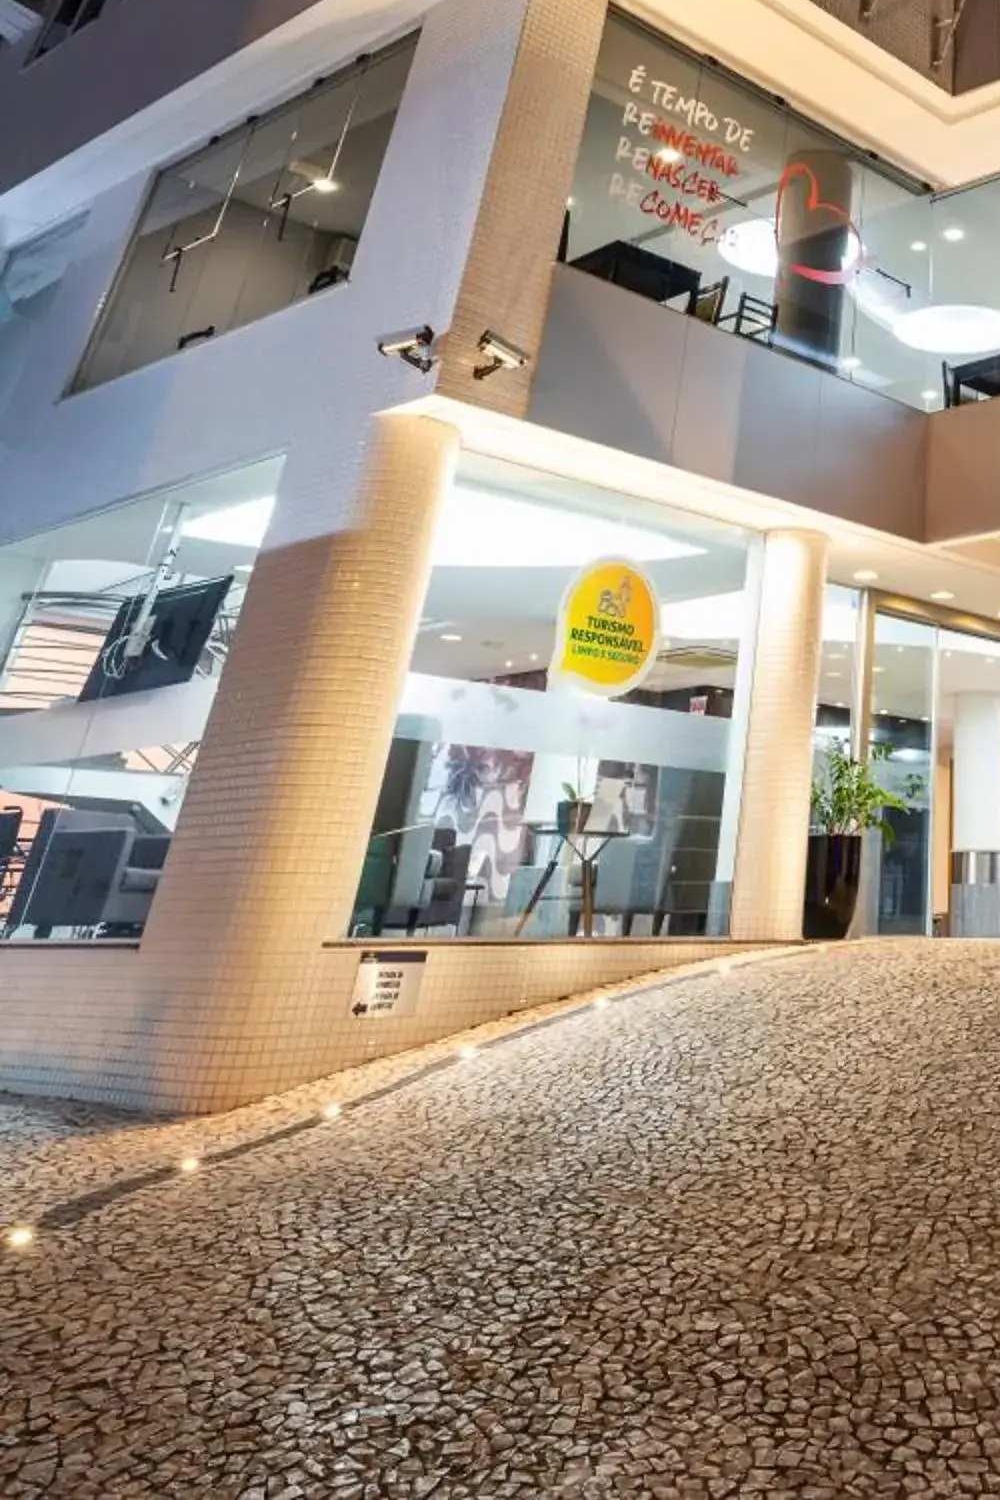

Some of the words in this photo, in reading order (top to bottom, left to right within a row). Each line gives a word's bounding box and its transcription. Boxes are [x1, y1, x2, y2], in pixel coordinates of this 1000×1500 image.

[629, 65, 647, 93] É
[651, 80, 718, 131] TEMPO
[723, 117, 755, 152] DE
[615, 136, 722, 203] RENASCER
[609, 173, 740, 248] RECOMEÇ
[586, 615, 635, 636] TURISMO
